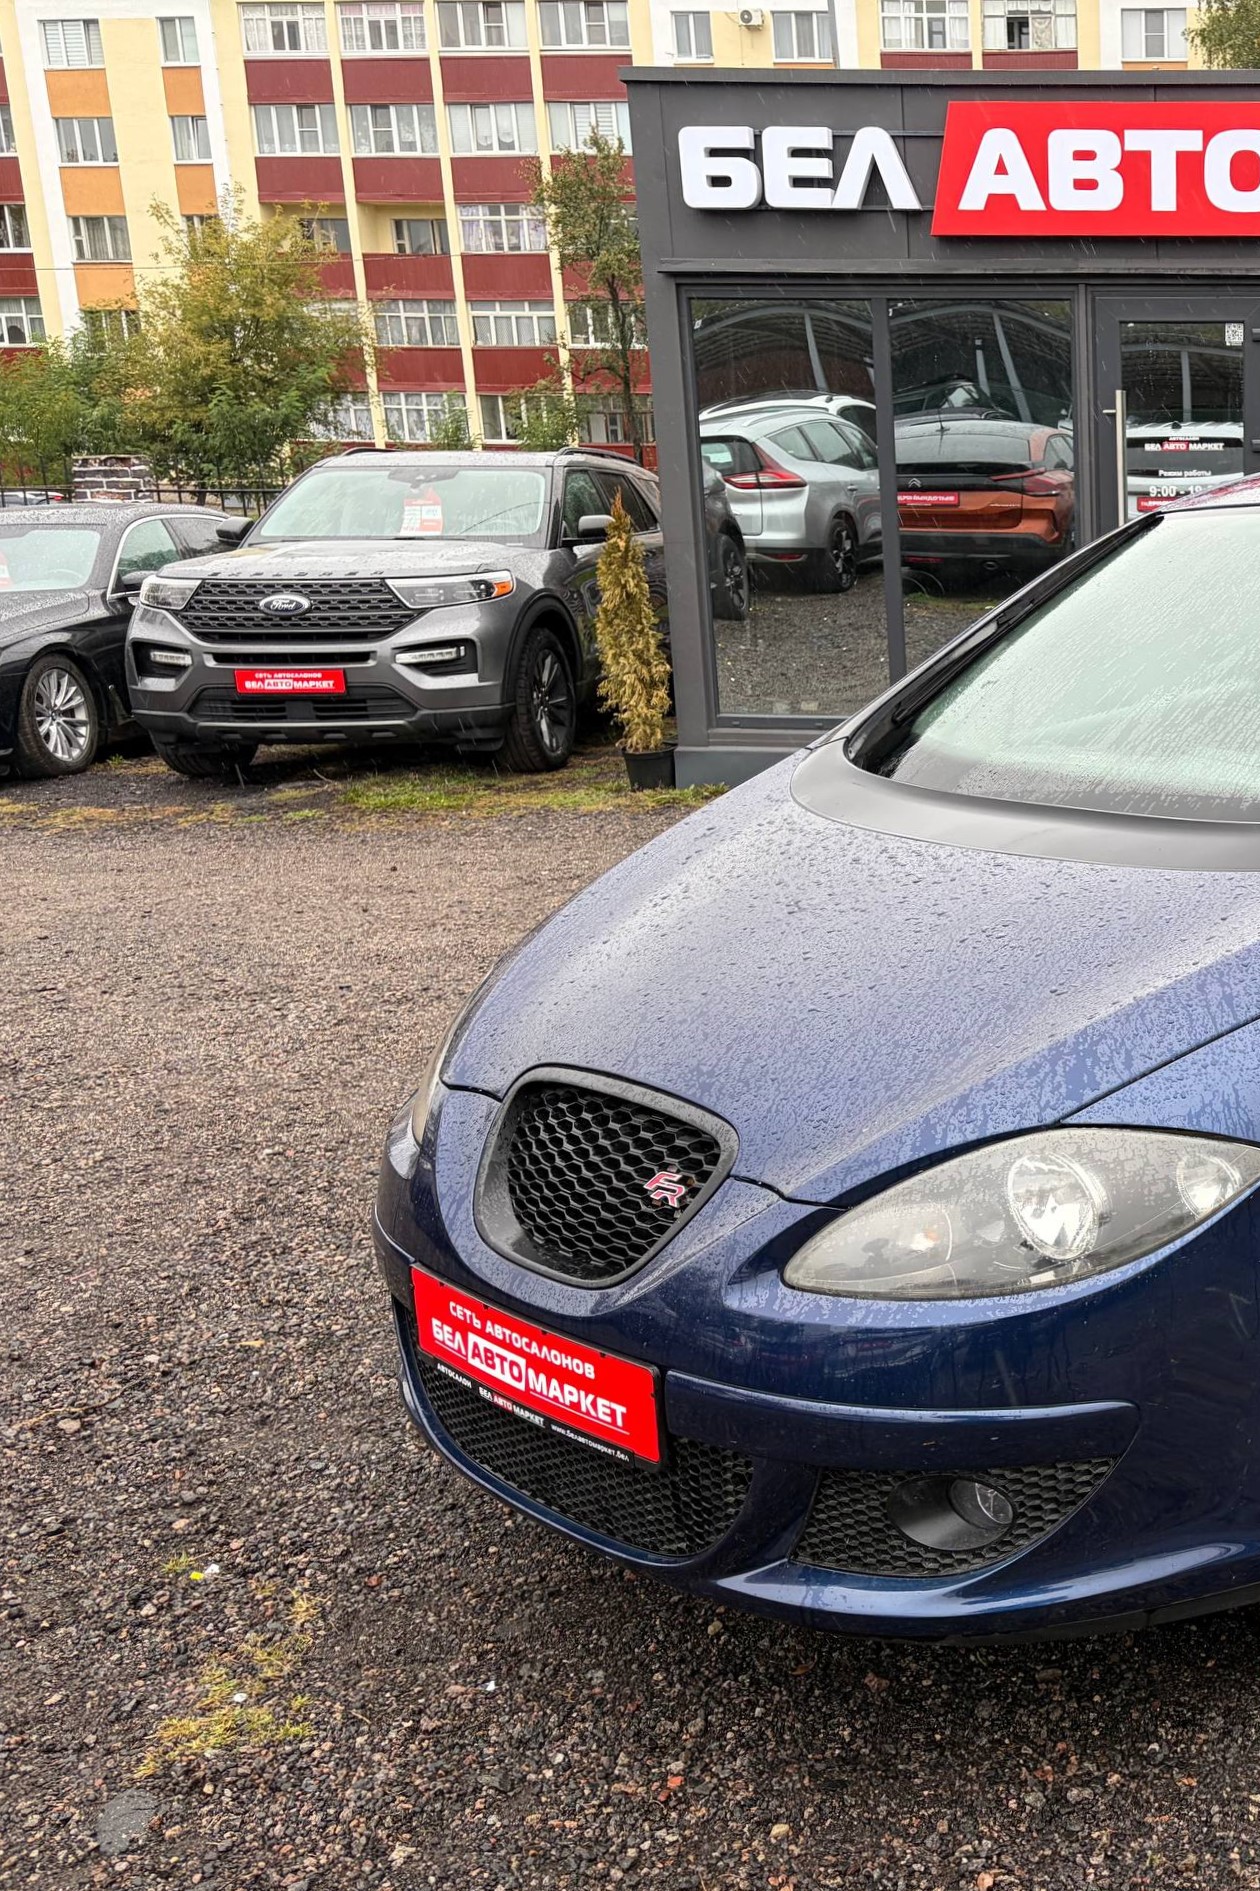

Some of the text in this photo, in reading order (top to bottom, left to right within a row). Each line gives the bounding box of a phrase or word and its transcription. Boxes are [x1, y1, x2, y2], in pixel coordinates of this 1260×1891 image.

[678, 125, 923, 211] БЕЛ
[1163, 442, 1188, 450] АВТО
[1189, 442, 1225, 452] МАРКЕТ
[1184, 469, 1212, 478] работы
[1149, 485, 1178, 497] 9:00
[270, 599, 296, 611] Ford
[293, 680, 335, 689] МАРКЕТ
[643, 1171, 686, 1208] FR
[449, 1300, 595, 1380] СЕТЬ АВТОСАЛОНОВ
[431, 1317, 627, 1428] БЕЛ АВТО МАРКЕТ
[437, 1363, 472, 1389] АВТОСАЛОН
[479, 1387, 493, 1401] БЕЛ
[493, 1395, 513, 1411] АВТО
[513, 1404, 545, 1427] МАРКЕТ
